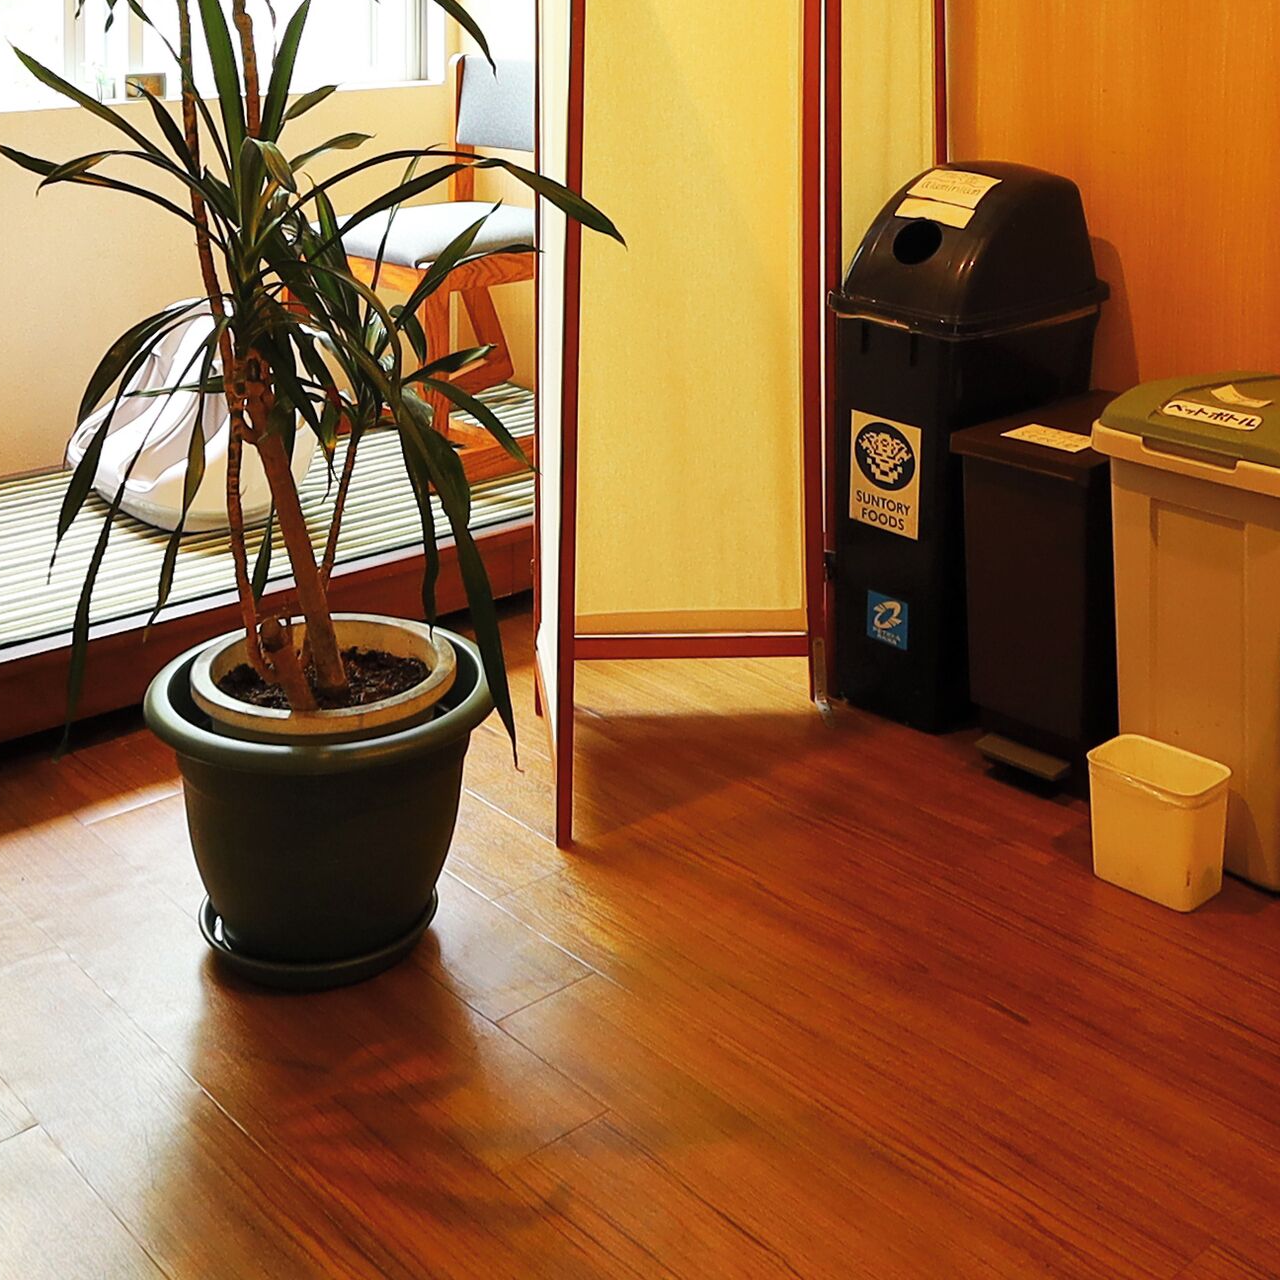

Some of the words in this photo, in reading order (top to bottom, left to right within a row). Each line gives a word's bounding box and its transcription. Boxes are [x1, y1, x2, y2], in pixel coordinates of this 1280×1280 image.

[1168, 404, 1256, 427] ペットボトル
[856, 490, 911, 516] SUNTORY
[861, 507, 905, 531] FOODS
